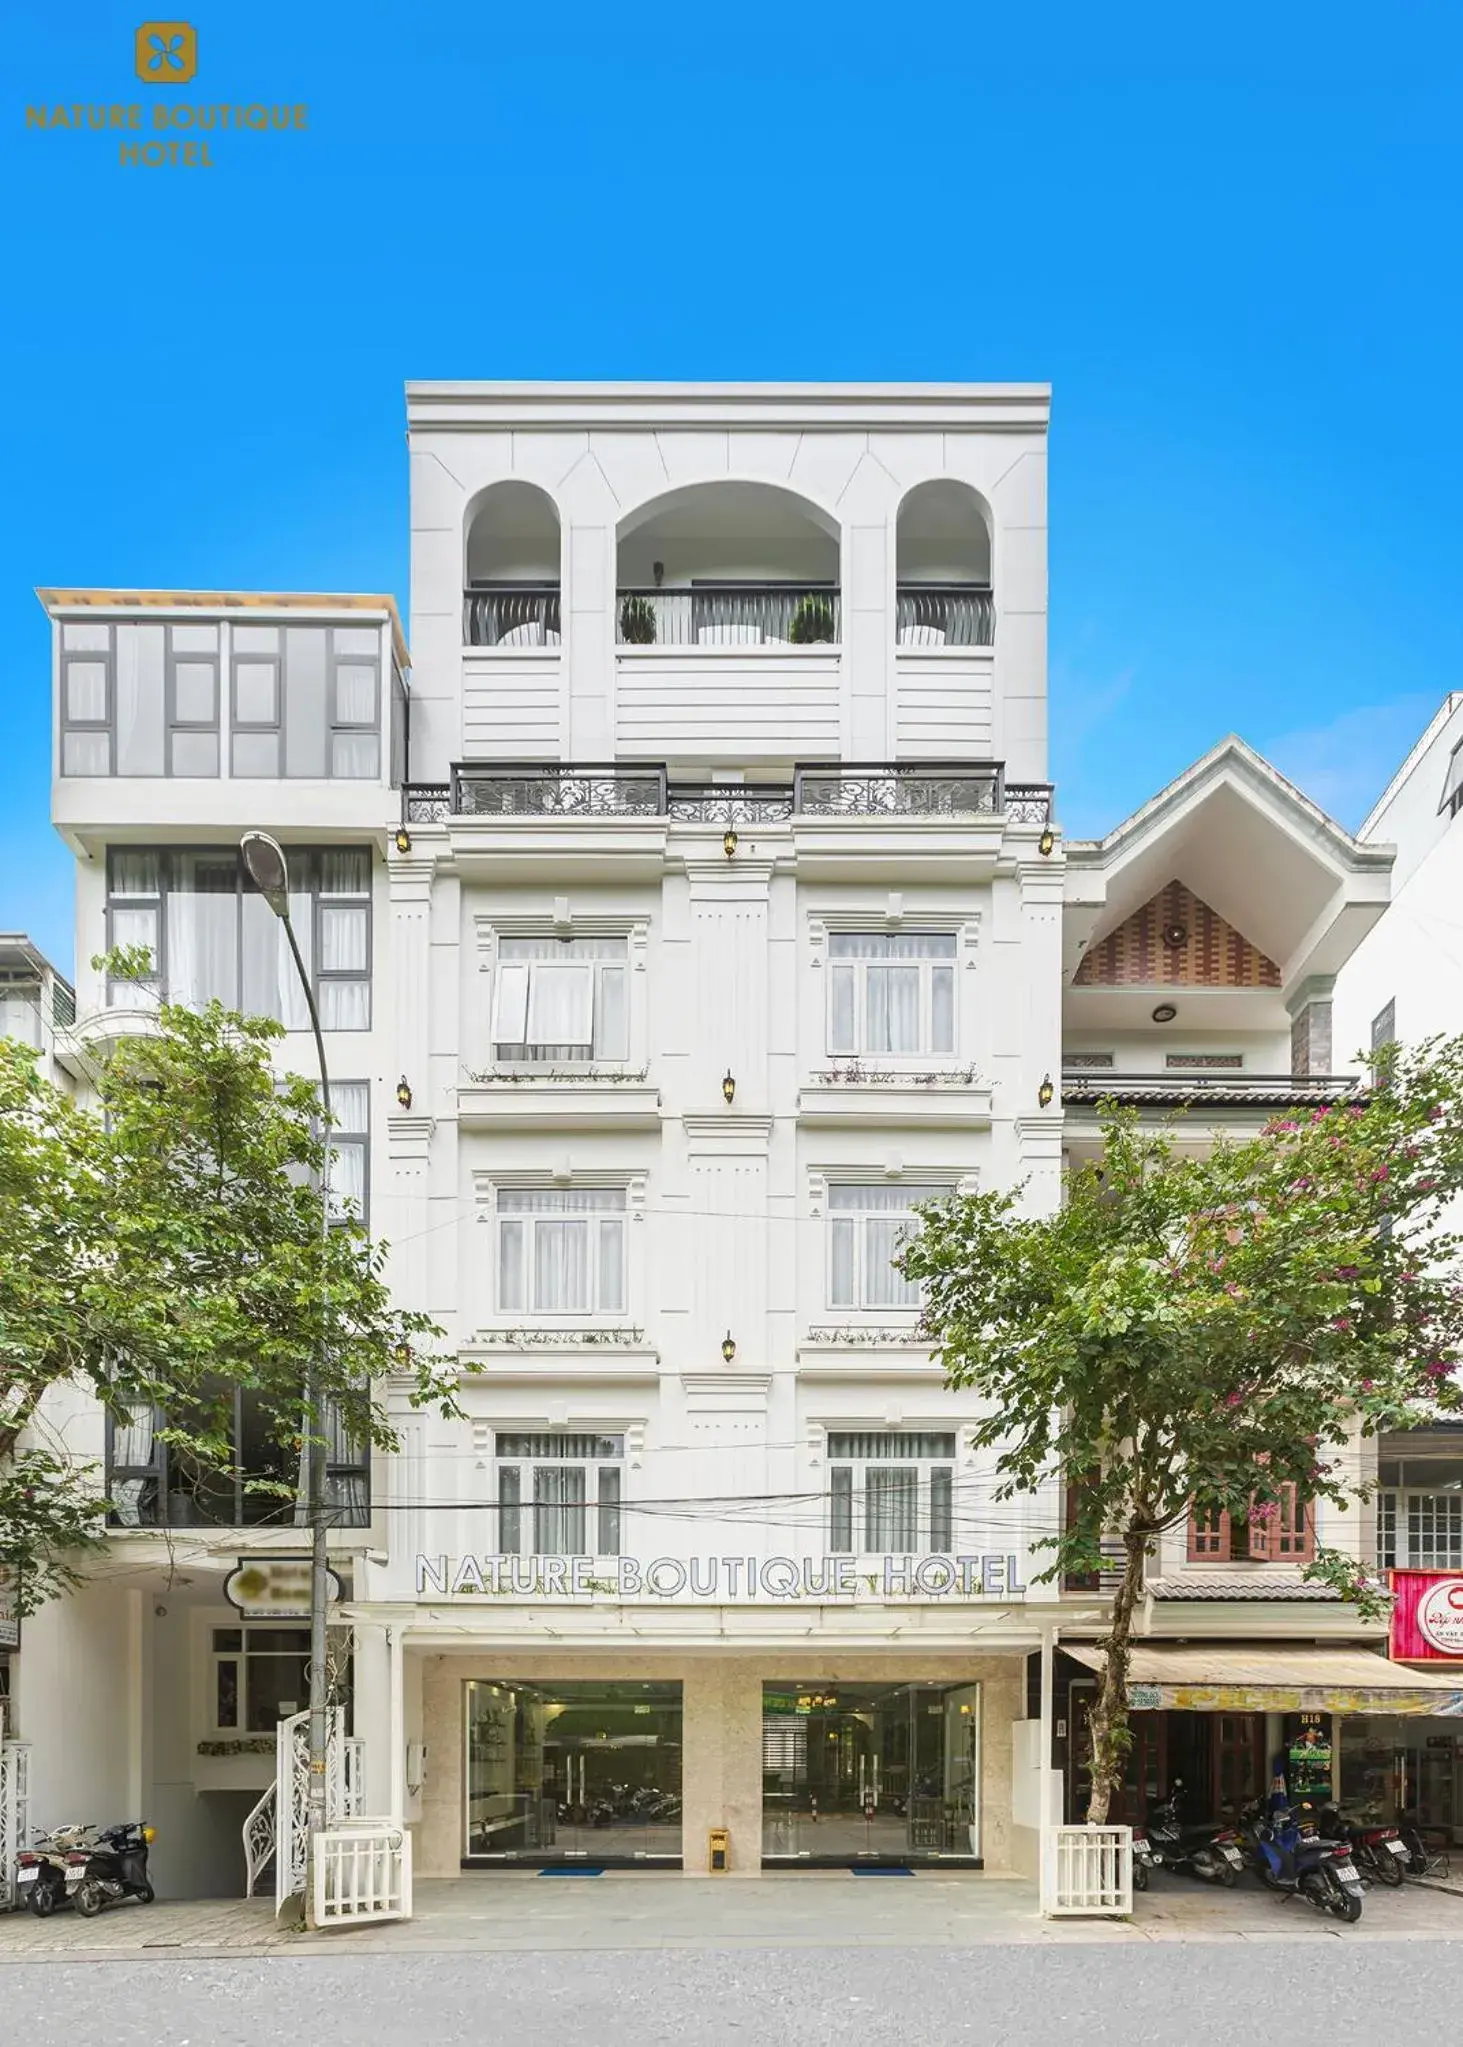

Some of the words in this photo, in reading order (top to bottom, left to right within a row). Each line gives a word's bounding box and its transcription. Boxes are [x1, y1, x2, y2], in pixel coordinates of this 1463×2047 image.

[416, 1554, 594, 1595] NATURE
[617, 1556, 858, 1598] BOUTIQUE
[883, 1555, 1027, 1595] HOTEL
